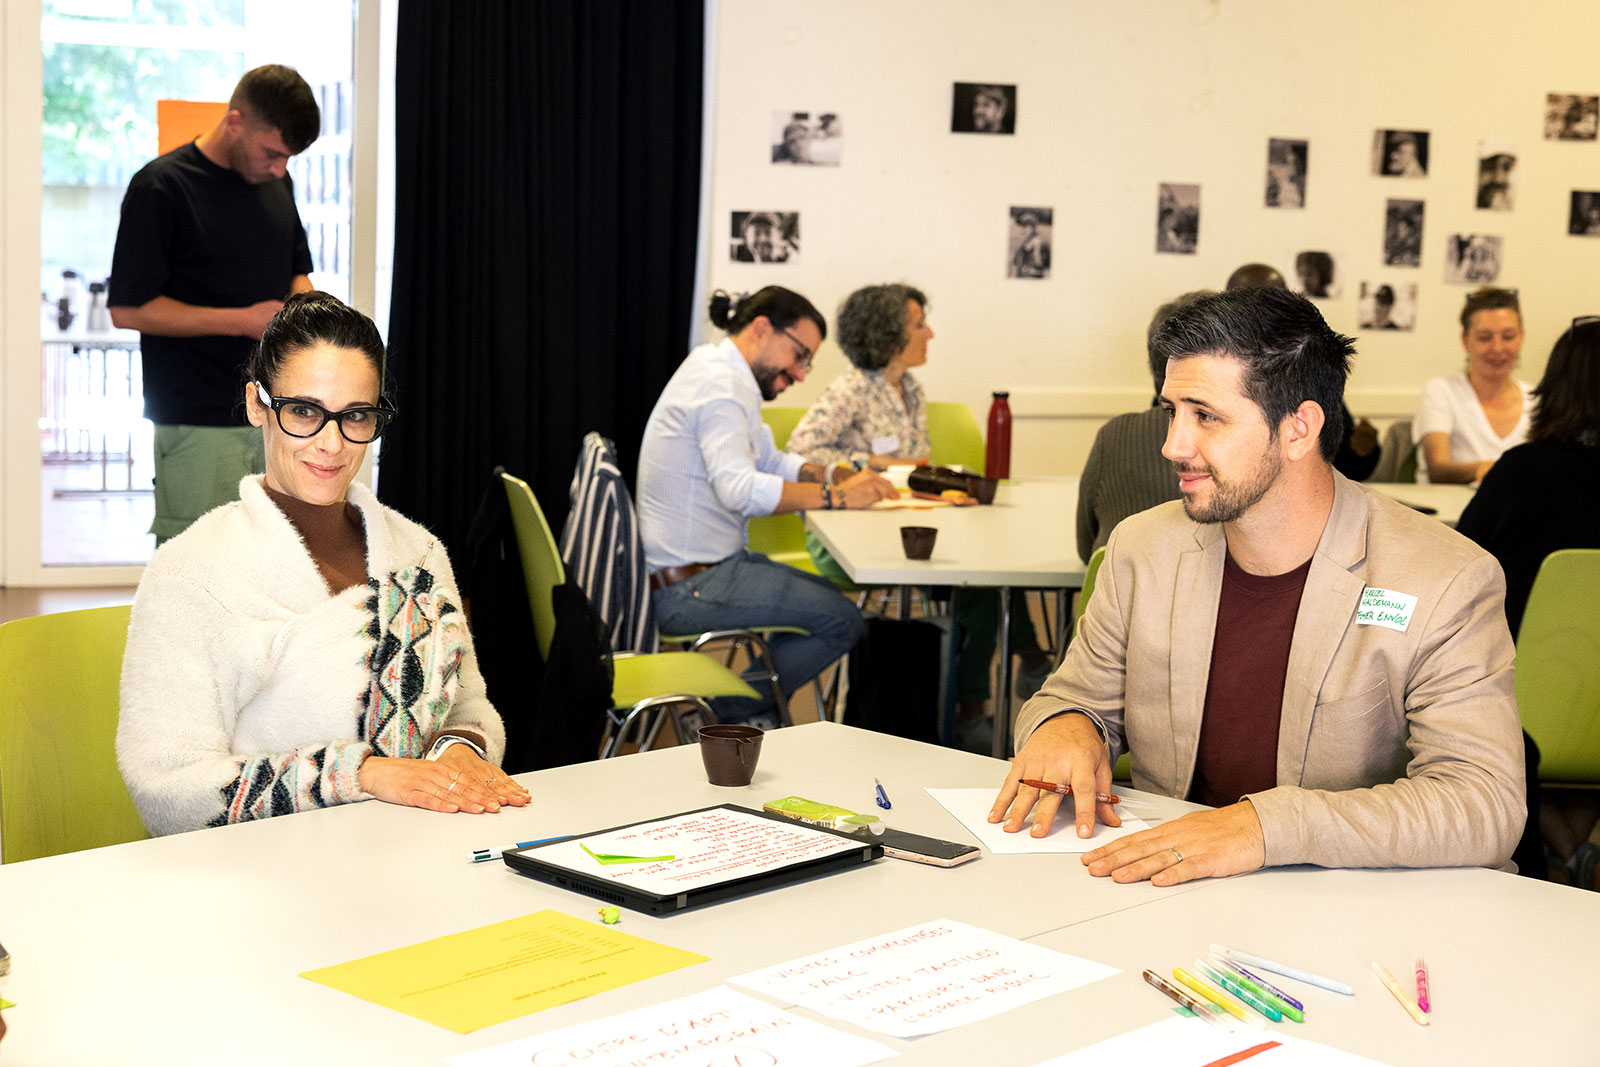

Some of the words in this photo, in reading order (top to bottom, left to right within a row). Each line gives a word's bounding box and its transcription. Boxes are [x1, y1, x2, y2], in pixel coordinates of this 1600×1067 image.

[1376, 611, 1408, 626] ENVOL
[776, 957, 838, 979] VISITES
[838, 975, 911, 1001] VISITES
[913, 949, 999, 976] TACTILES
[984, 972, 1053, 994] PUBLIC
[872, 982, 964, 1014] PARCOURS
